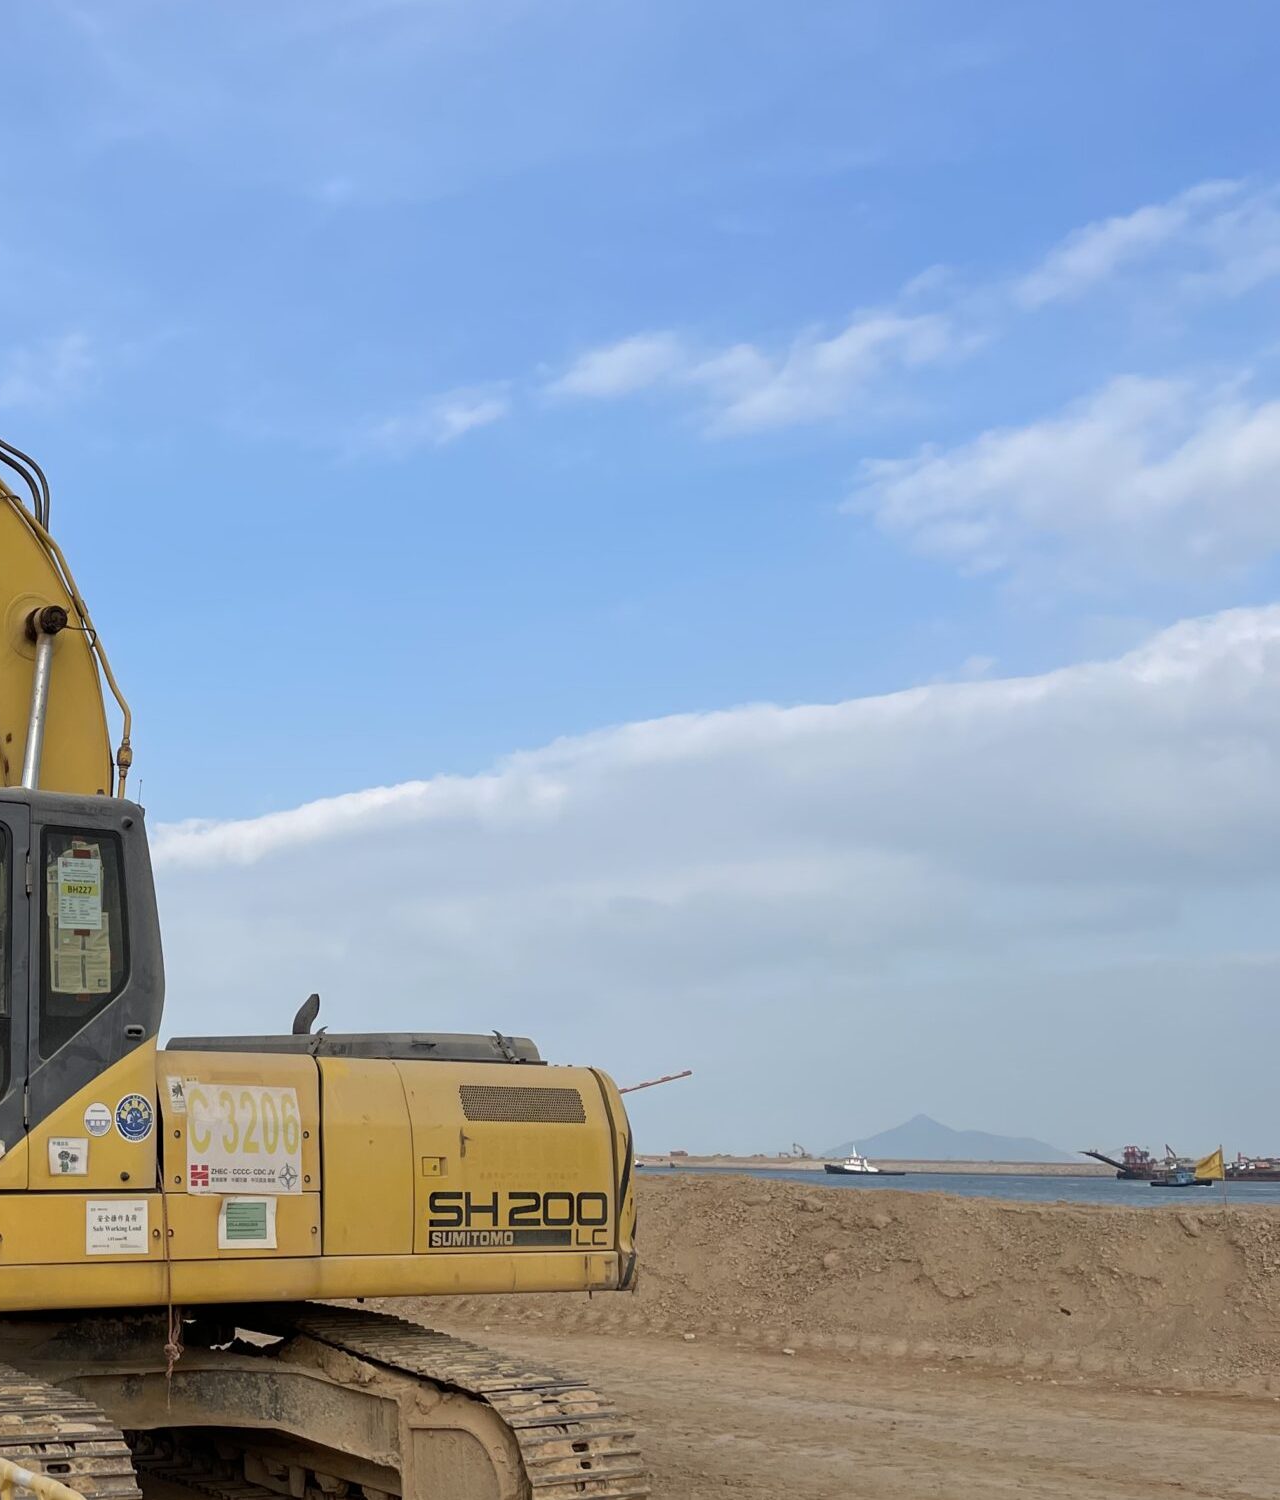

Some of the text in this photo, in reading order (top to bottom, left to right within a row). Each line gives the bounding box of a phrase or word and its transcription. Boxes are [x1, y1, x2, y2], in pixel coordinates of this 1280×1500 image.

[67, 885, 92, 894] BH227
[220, 1090, 299, 1156] 3206
[105, 1225, 127, 1233] Working
[576, 1229, 607, 1245] LC
[431, 1231, 514, 1247] SUMITOMO
